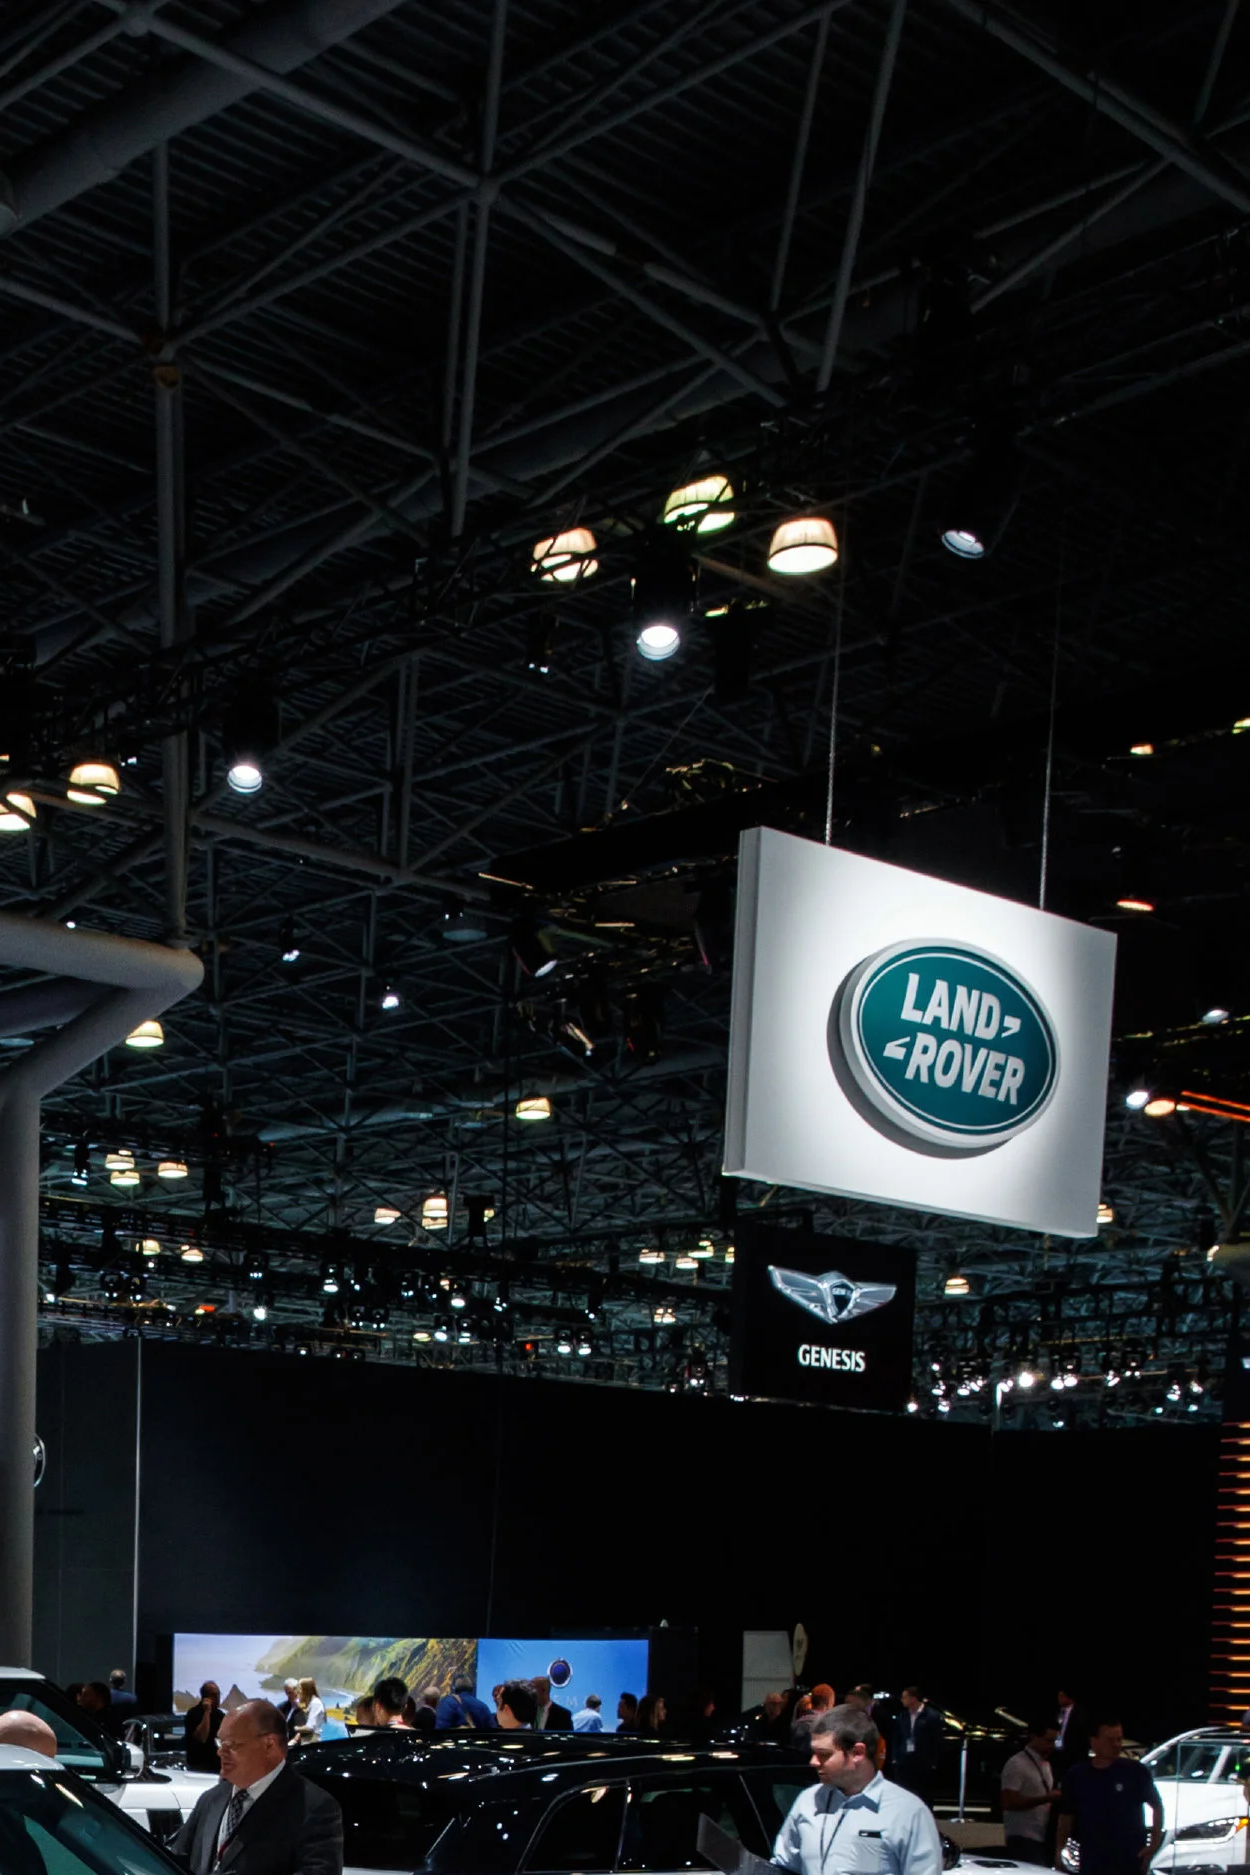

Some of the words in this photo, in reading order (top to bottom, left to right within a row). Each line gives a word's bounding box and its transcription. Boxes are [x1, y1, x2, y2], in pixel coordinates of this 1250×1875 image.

[901, 972, 1001, 1040] LAND
[904, 1031, 1026, 1105] ROVER
[798, 1344, 866, 1372] GENESIS
